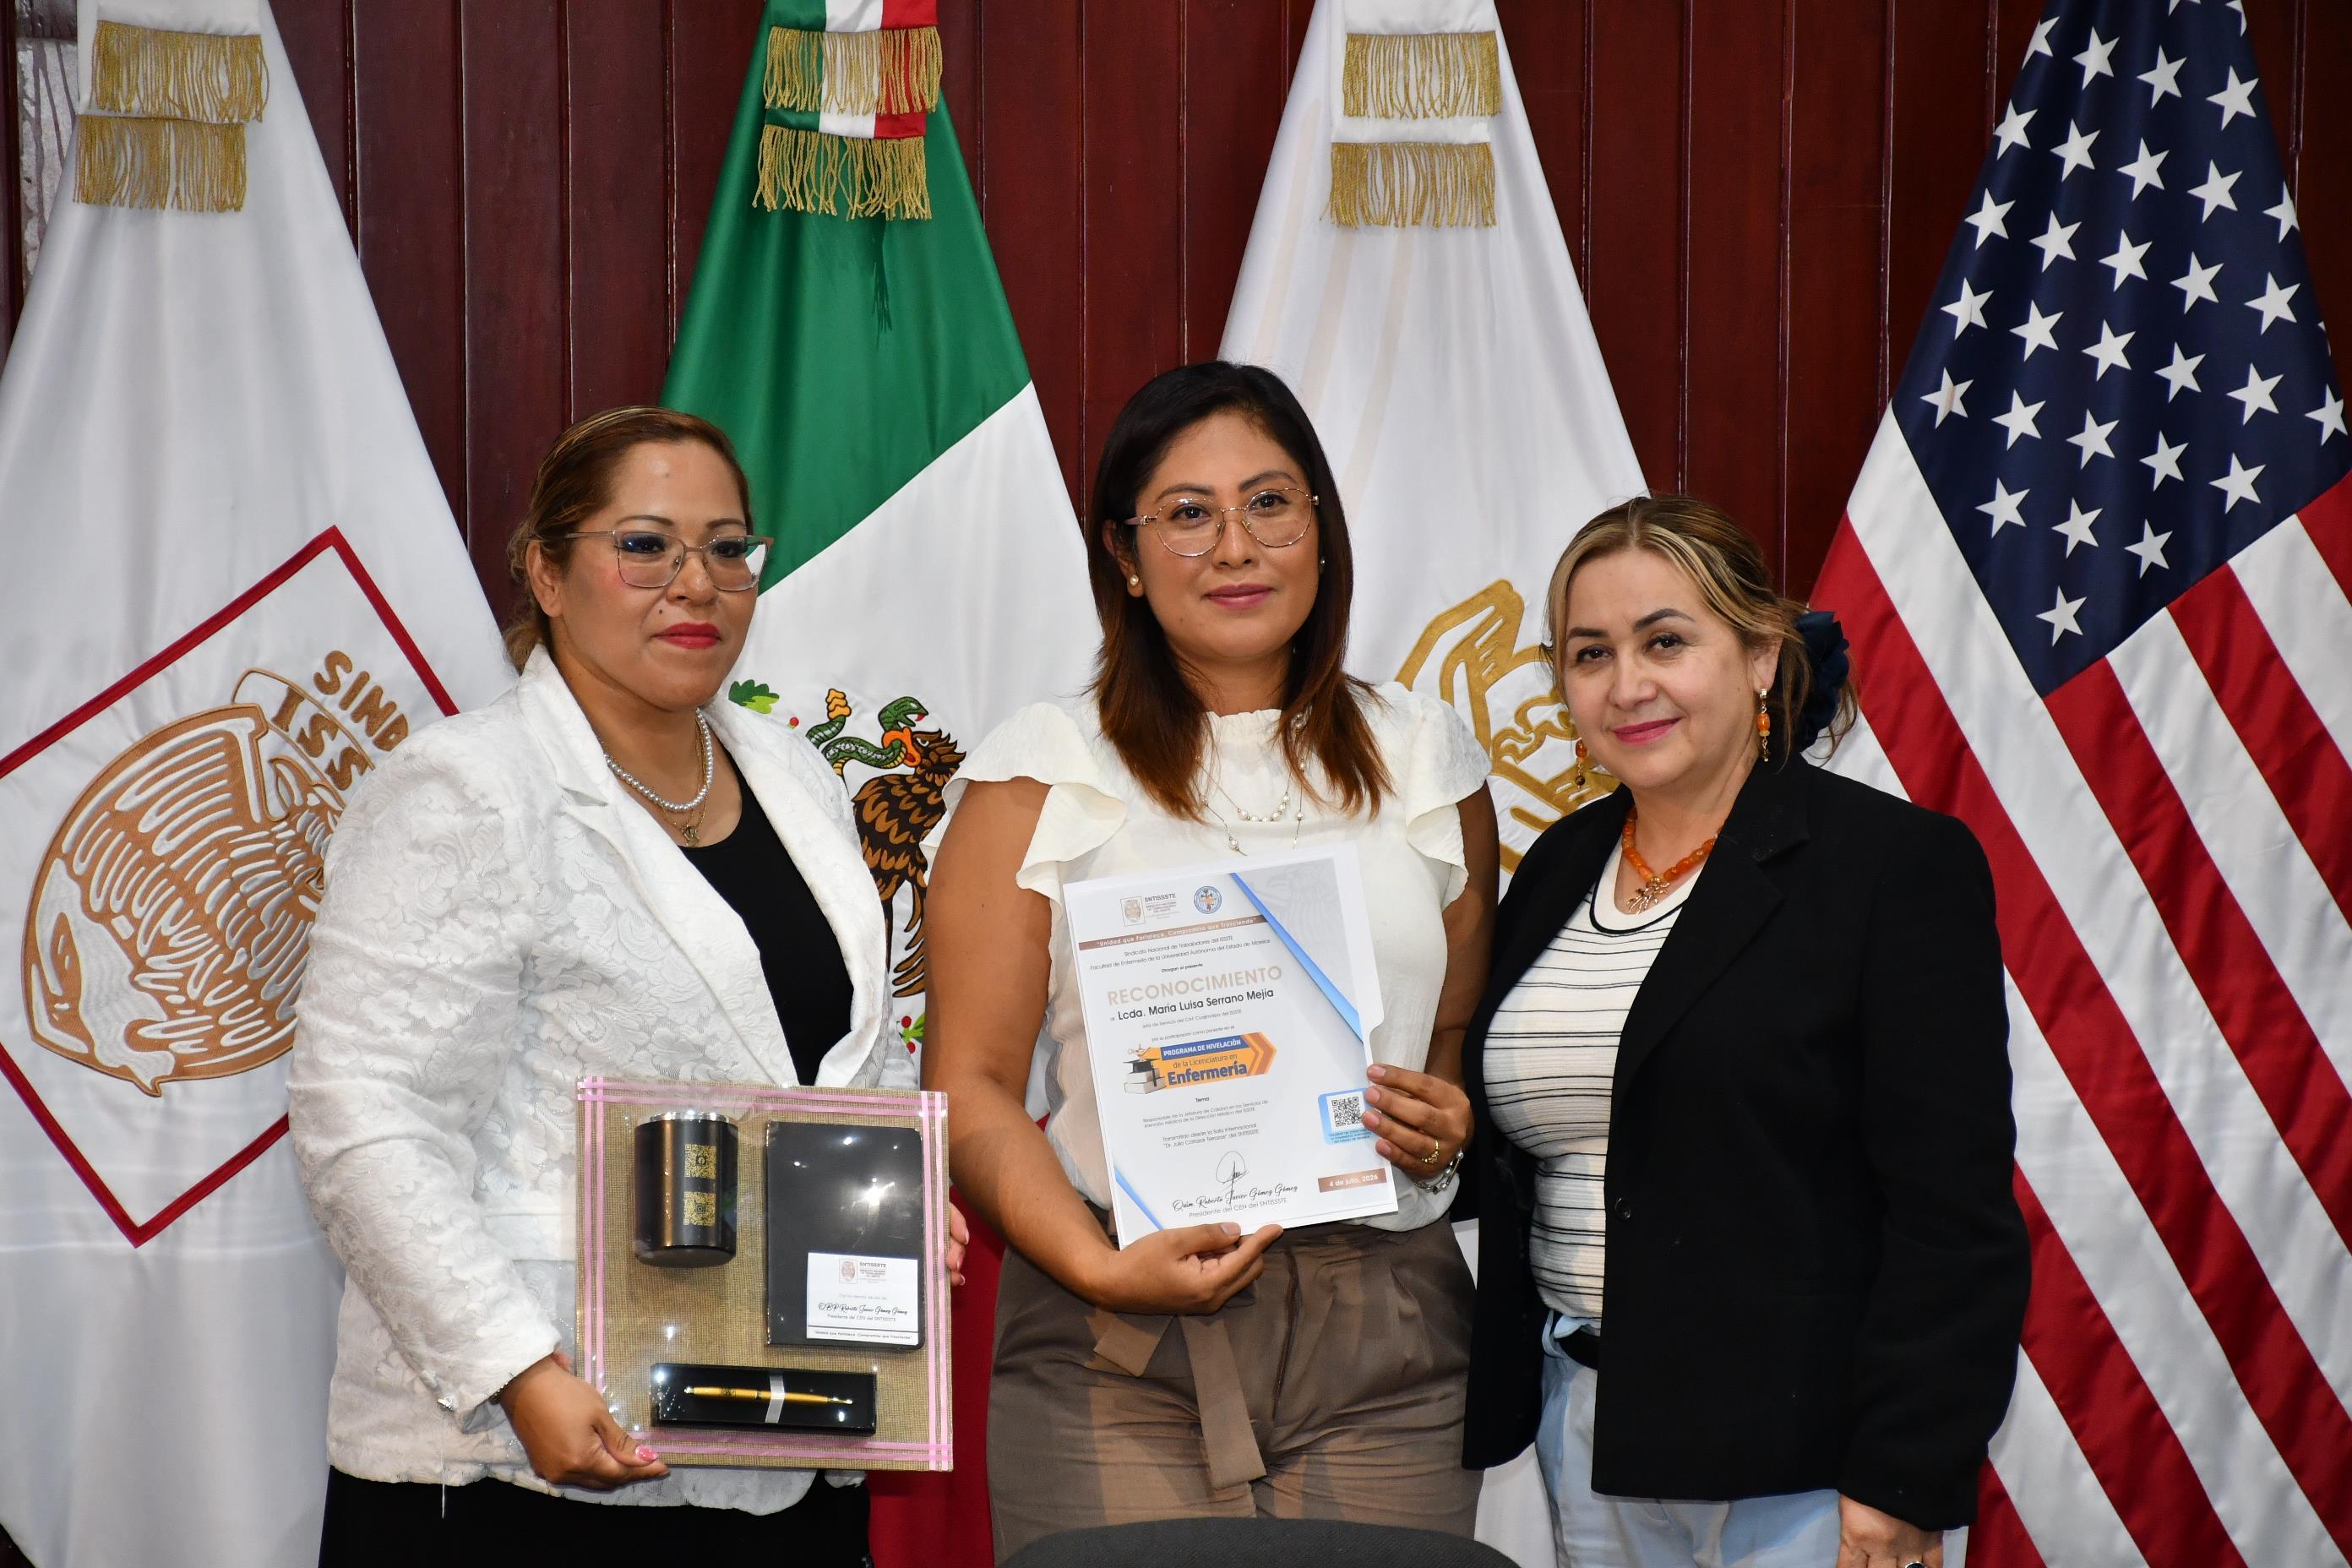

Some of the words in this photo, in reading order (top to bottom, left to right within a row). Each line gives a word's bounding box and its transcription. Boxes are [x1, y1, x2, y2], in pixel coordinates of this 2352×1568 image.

[1144, 893, 1176, 903] SNTISSSTE
[1148, 945, 1170, 953] Nacional
[1108, 966, 1282, 1005] RECONOCIMIENTO
[1118, 1009, 1146, 1020] Lcda.
[1149, 1003, 1177, 1015] María
[1179, 999, 1204, 1010] Luisa
[1206, 994, 1244, 1007] Serrano
[1246, 988, 1274, 1000] Mejía
[1163, 1045, 1197, 1057] PROGRAMA
[1206, 1038, 1241, 1049] NIVELACIÓN
[1190, 1054, 1228, 1066] Licenciatura
[1168, 1060, 1248, 1086] Enfermería
[1189, 1210, 1222, 1218] Presidente
[1222, 1206, 1233, 1214] del
[1260, 1197, 1288, 1207] SNTISSSTE
[1195, 1195, 1223, 1209] Roberto
[1225, 1190, 1247, 1205] Javier
